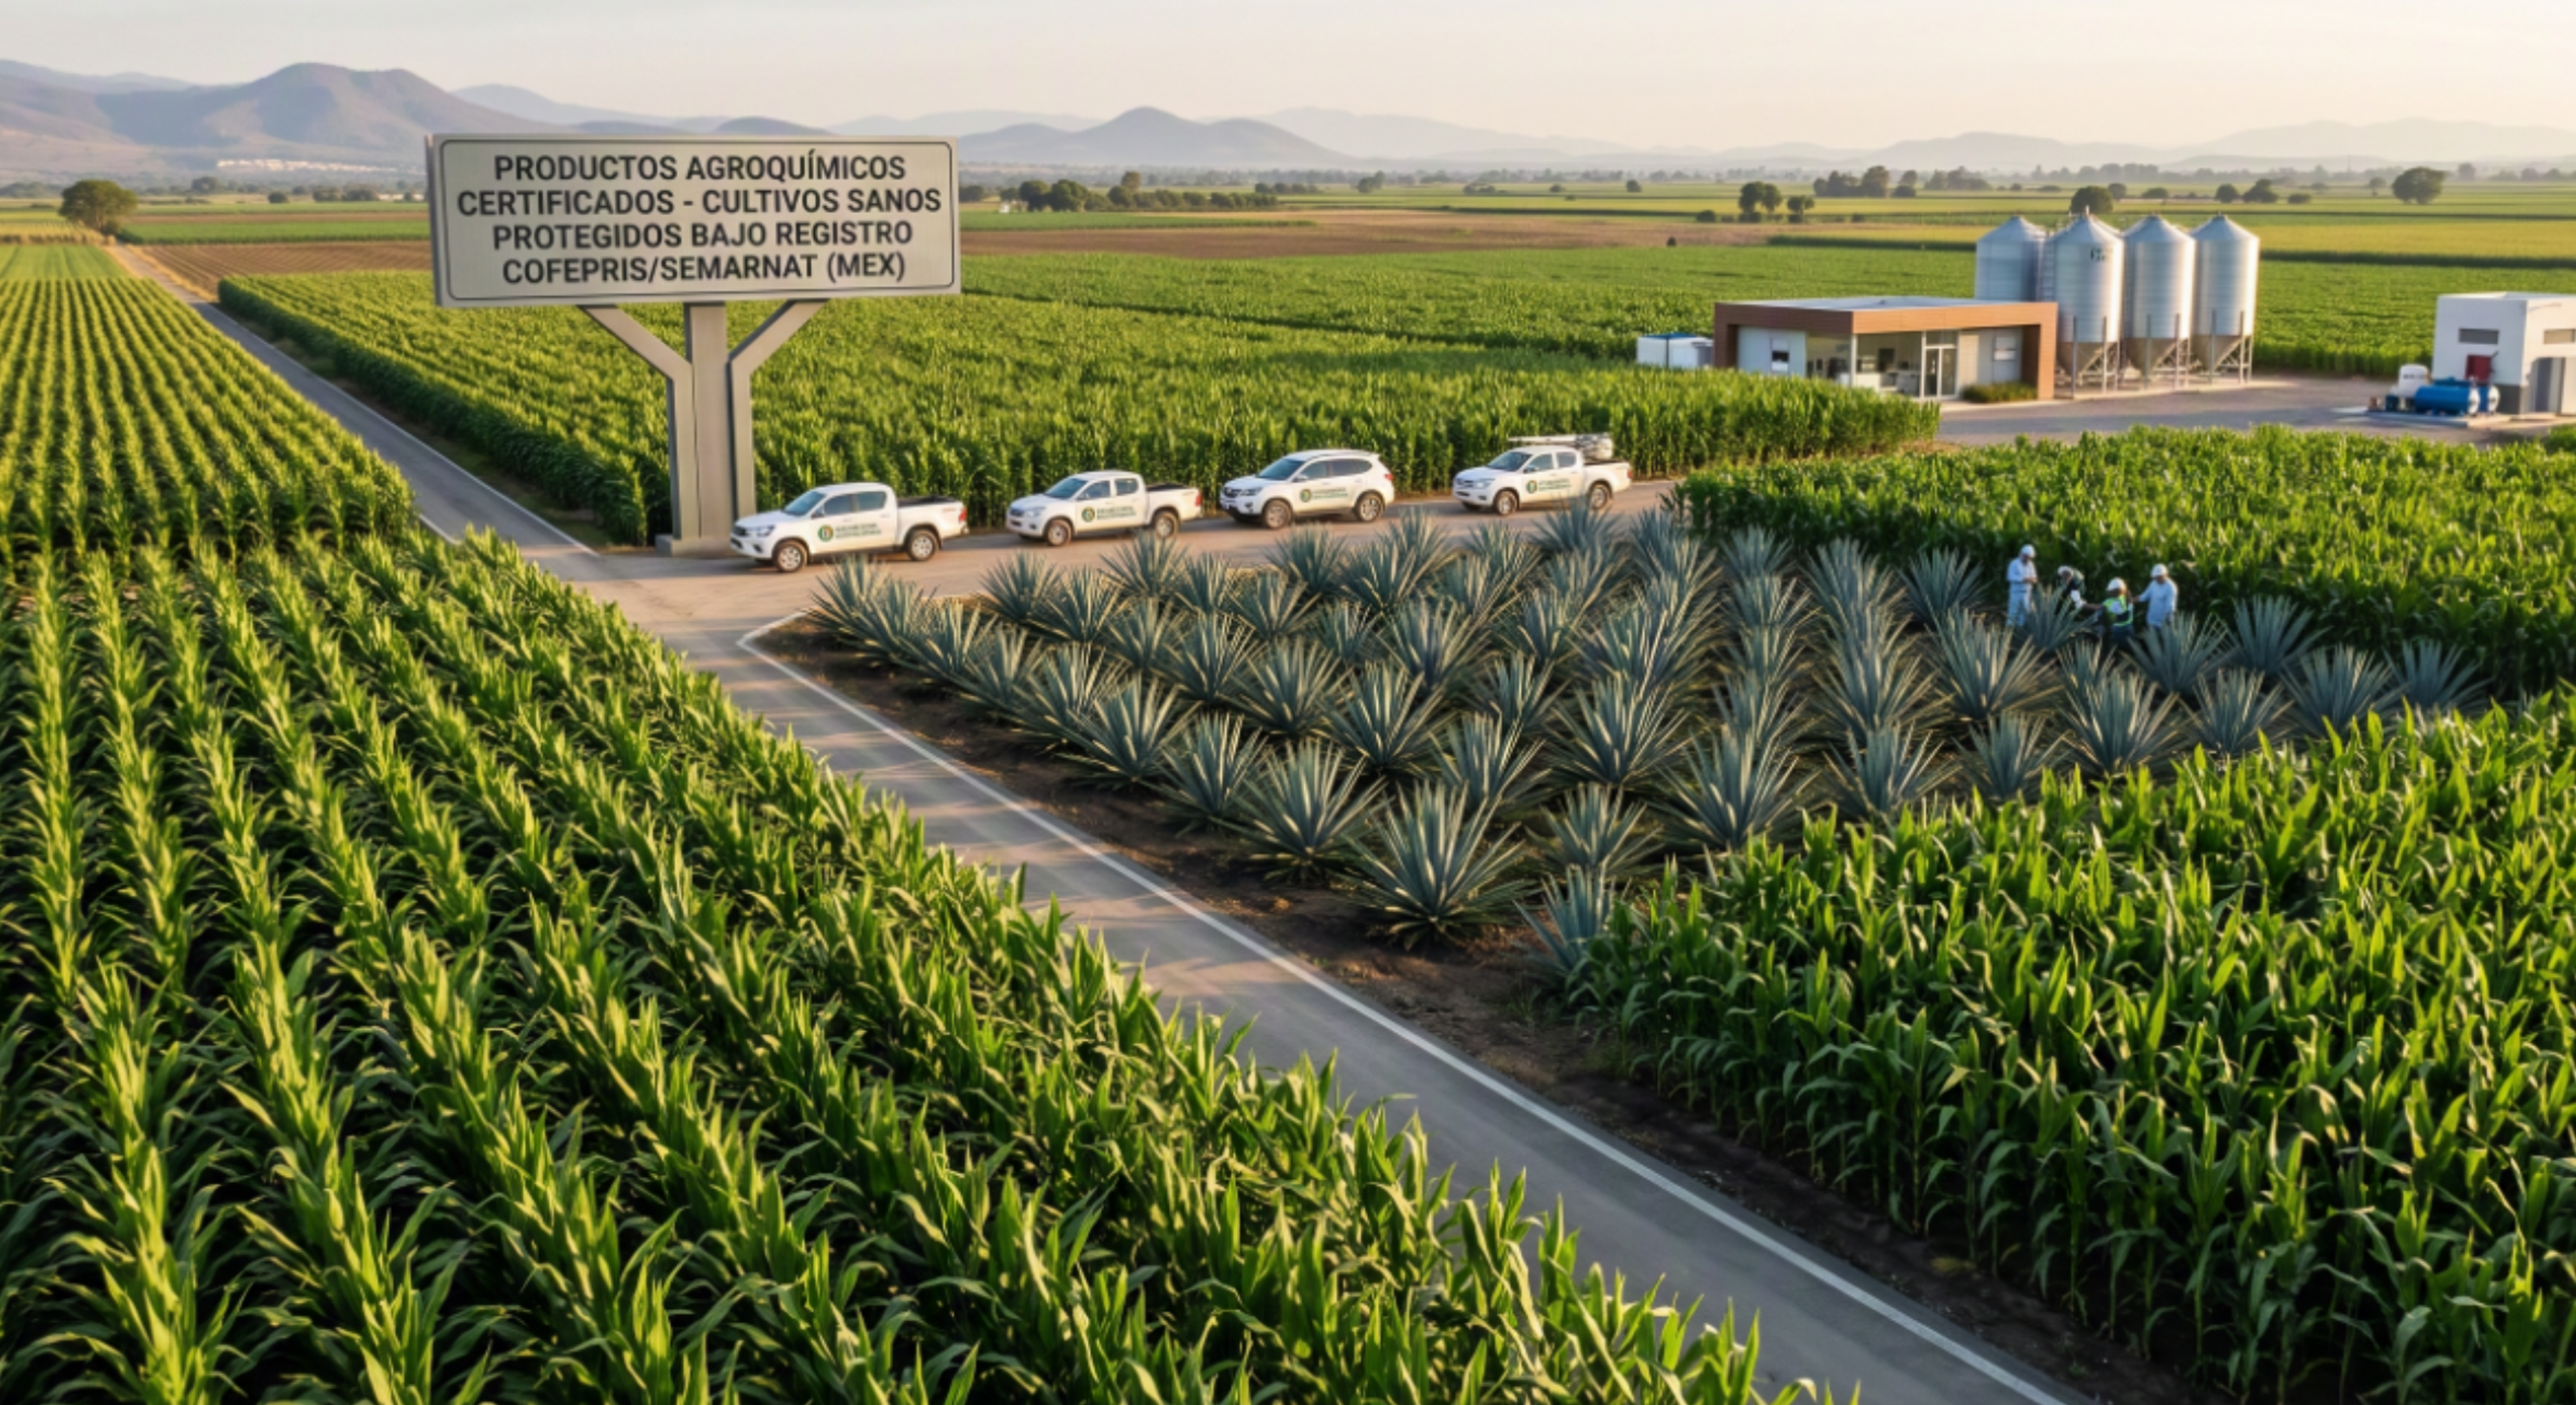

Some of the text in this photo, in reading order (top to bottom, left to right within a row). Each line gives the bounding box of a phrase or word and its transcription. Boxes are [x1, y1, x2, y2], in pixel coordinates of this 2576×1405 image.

[494, 148, 906, 183] PRODUCTOS AGROQUÍMICOS
[457, 189, 675, 216] CERTIFICADOS
[702, 188, 840, 214] CULTIVOS
[847, 188, 942, 213] SANOS
[492, 220, 913, 251] PROTEGIDOS BAJO REGISTRO
[502, 251, 905, 285] COFEPRIS/SEMARNAT (MEX)
